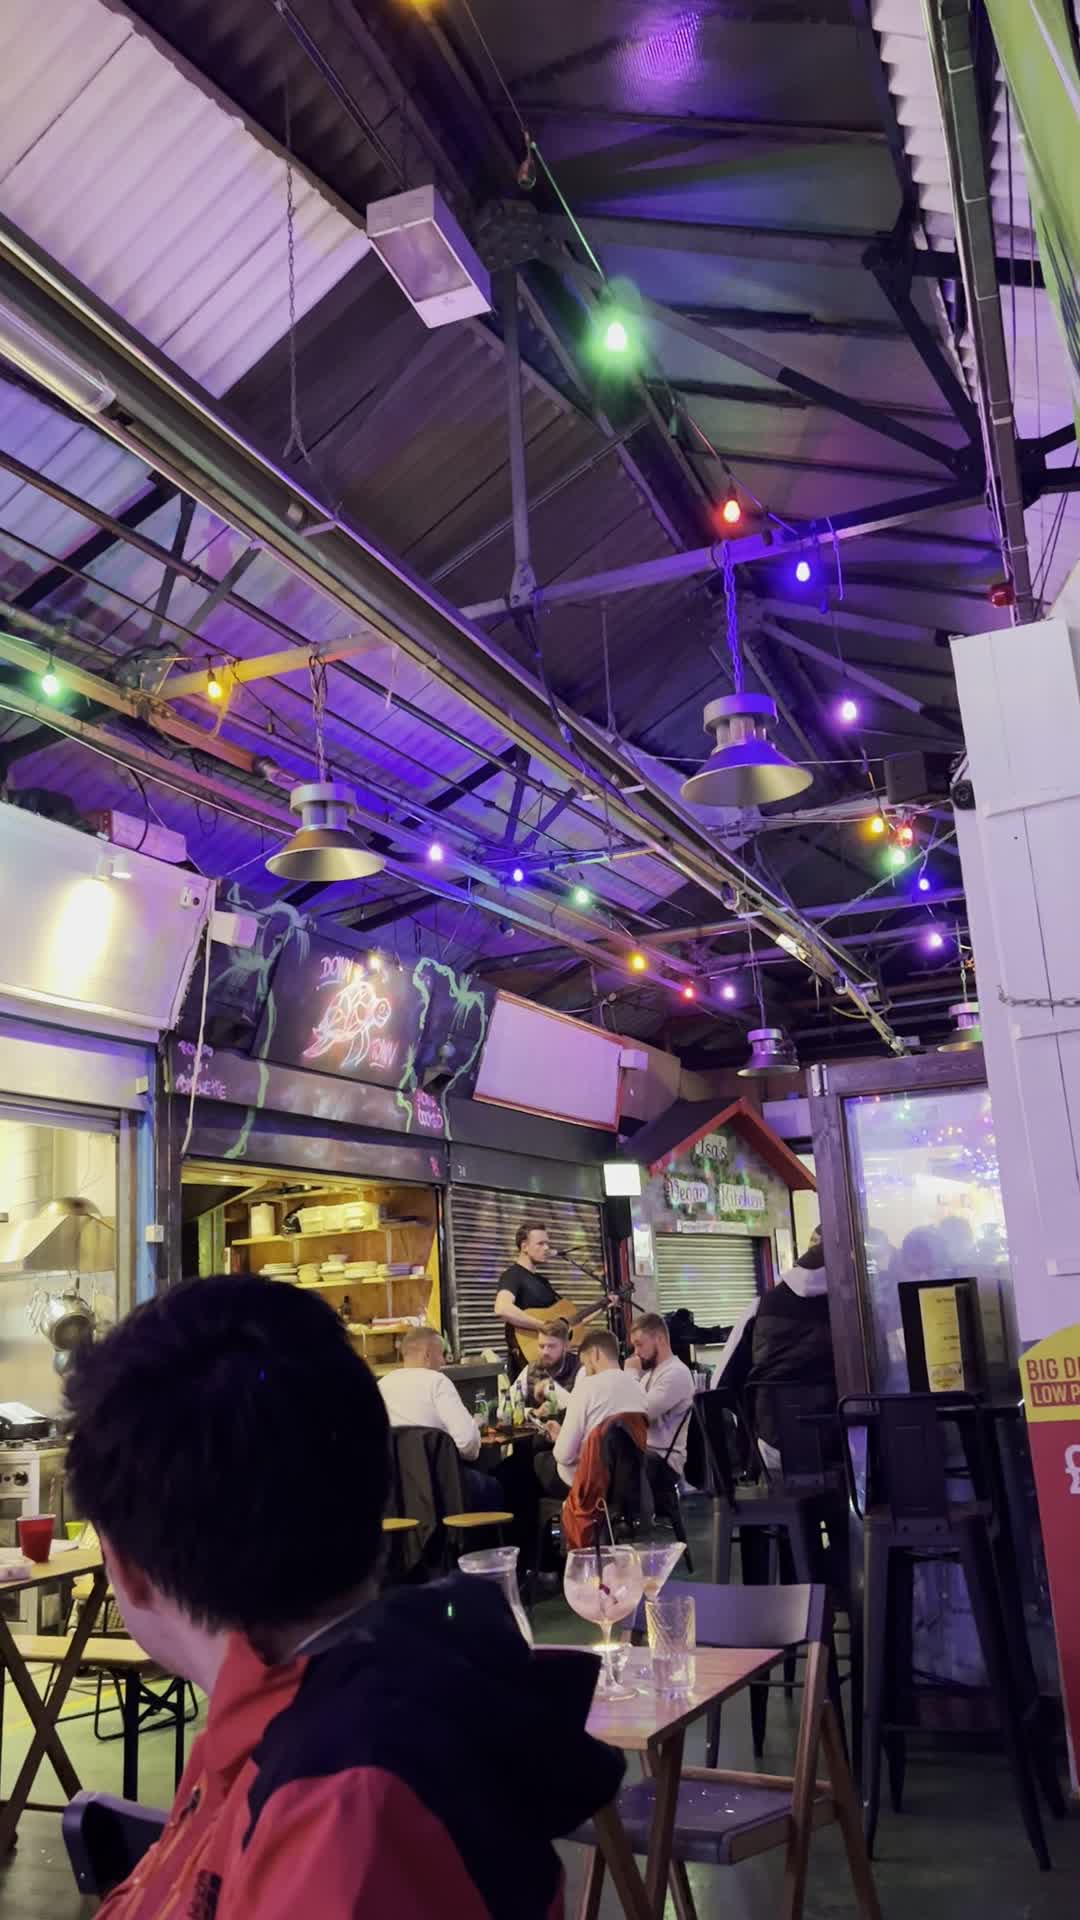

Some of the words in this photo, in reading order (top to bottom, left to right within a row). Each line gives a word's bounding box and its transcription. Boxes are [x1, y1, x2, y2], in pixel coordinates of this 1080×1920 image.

[672, 1179, 707, 1204] Vegan
[1026, 1358, 1058, 1381] BIG
[1064, 1356, 1080, 1379] D
[1032, 1384, 1066, 1404] LOW
